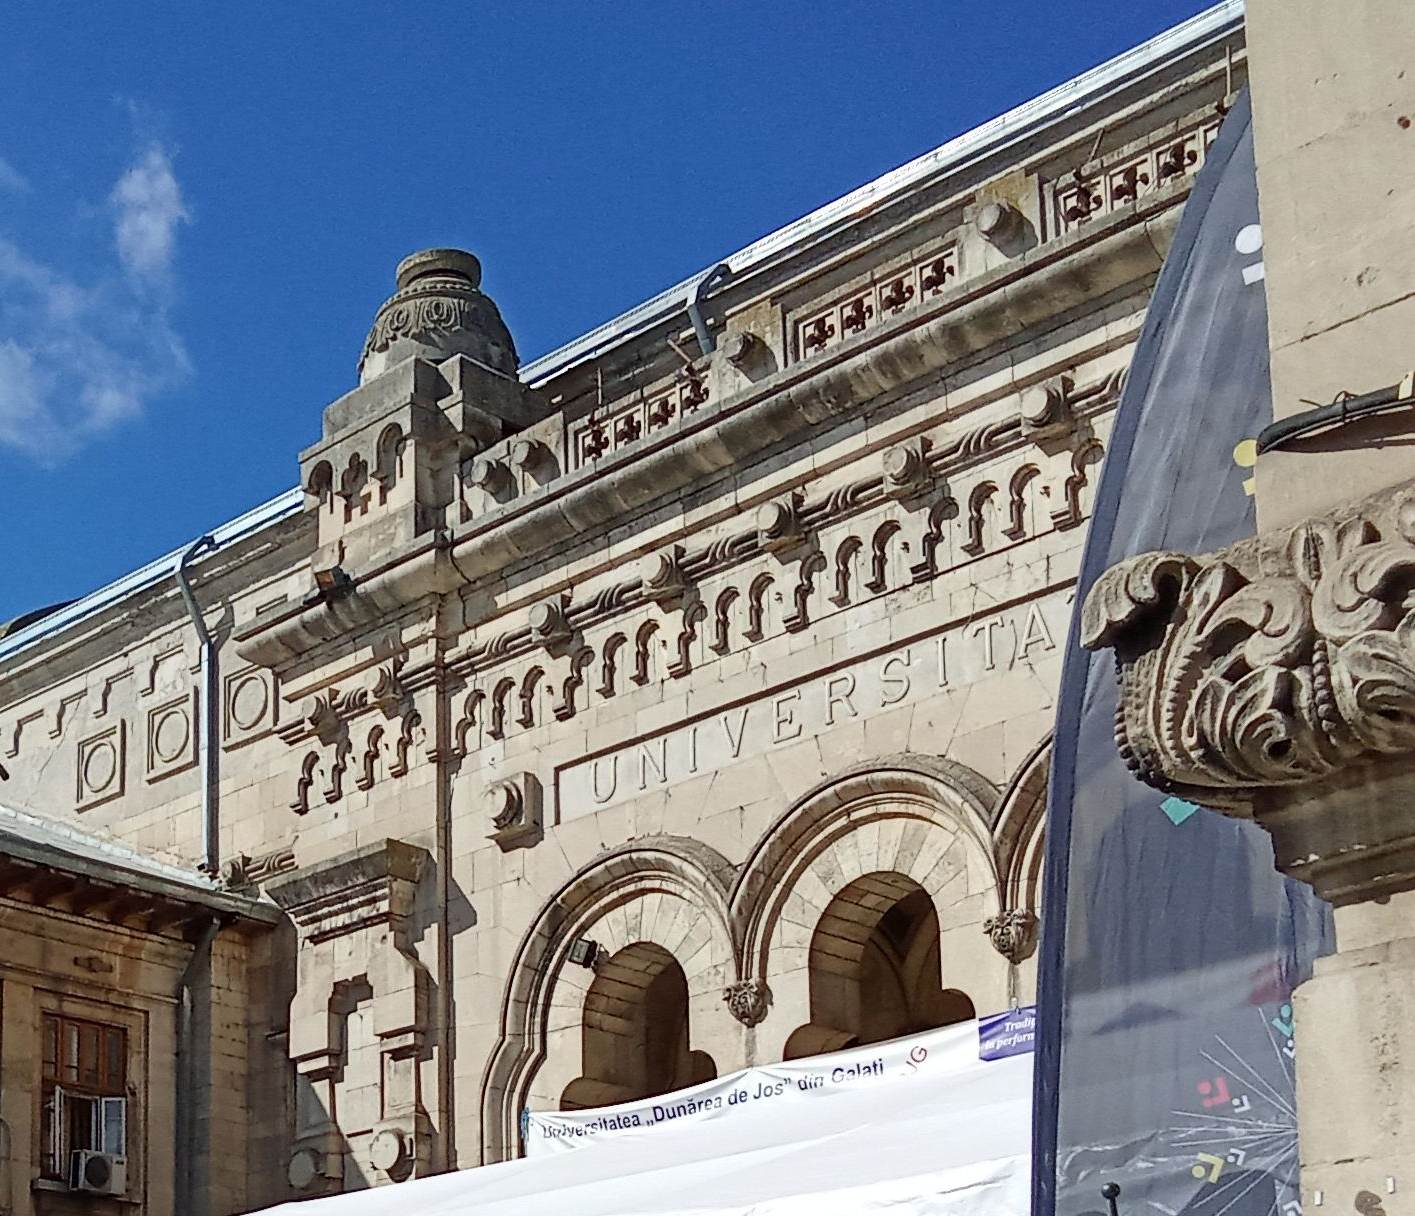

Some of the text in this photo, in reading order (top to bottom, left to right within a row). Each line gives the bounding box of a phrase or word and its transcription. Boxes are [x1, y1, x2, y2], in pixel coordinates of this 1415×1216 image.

[587, 597, 1075, 804] UNIVERSITA
[727, 1088, 749, 1106] de
[797, 1073, 824, 1092] din
